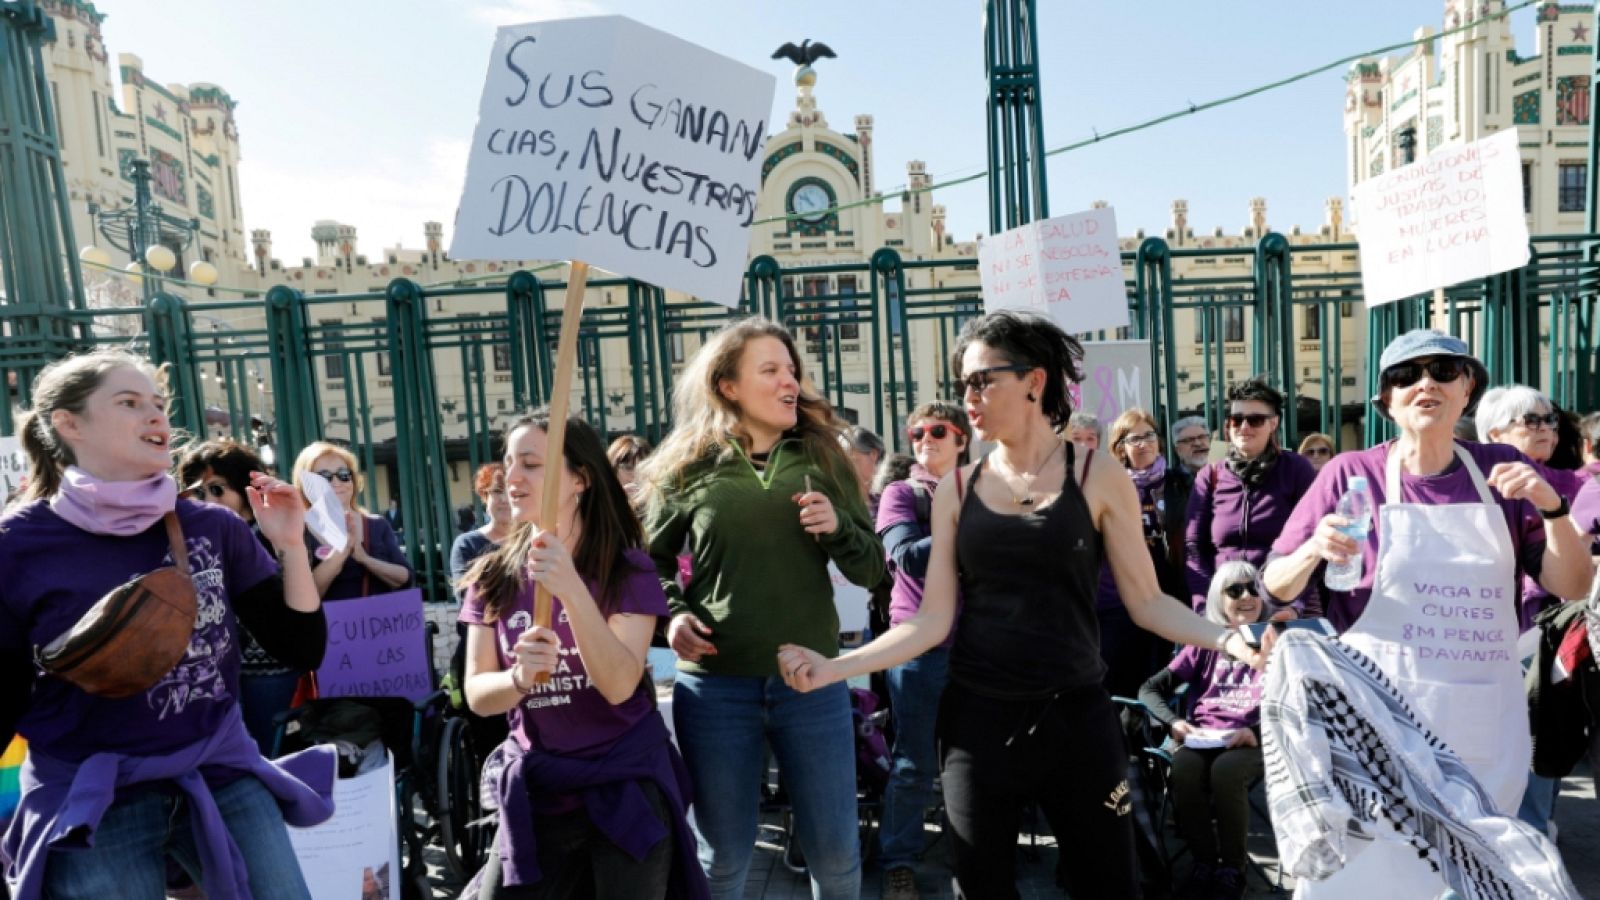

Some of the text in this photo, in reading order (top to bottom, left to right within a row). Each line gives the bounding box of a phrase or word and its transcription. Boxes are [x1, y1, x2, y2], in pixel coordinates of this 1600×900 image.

[505, 36, 613, 109] SUS
[487, 127, 757, 228] CIAS, NUESTRAS
[488, 174, 718, 268] DOLENCIAS
[1038, 219, 1099, 240] SALUD
[1398, 206, 1488, 239] MUJERES
[1426, 227, 1491, 253] LUCHA
[1413, 582, 1504, 599] VAGA DE
[1422, 603, 1494, 620] CURES
[329, 611, 422, 645] CUIDAMOS
[1402, 623, 1436, 641] 8M
[339, 646, 406, 670] A LAS
